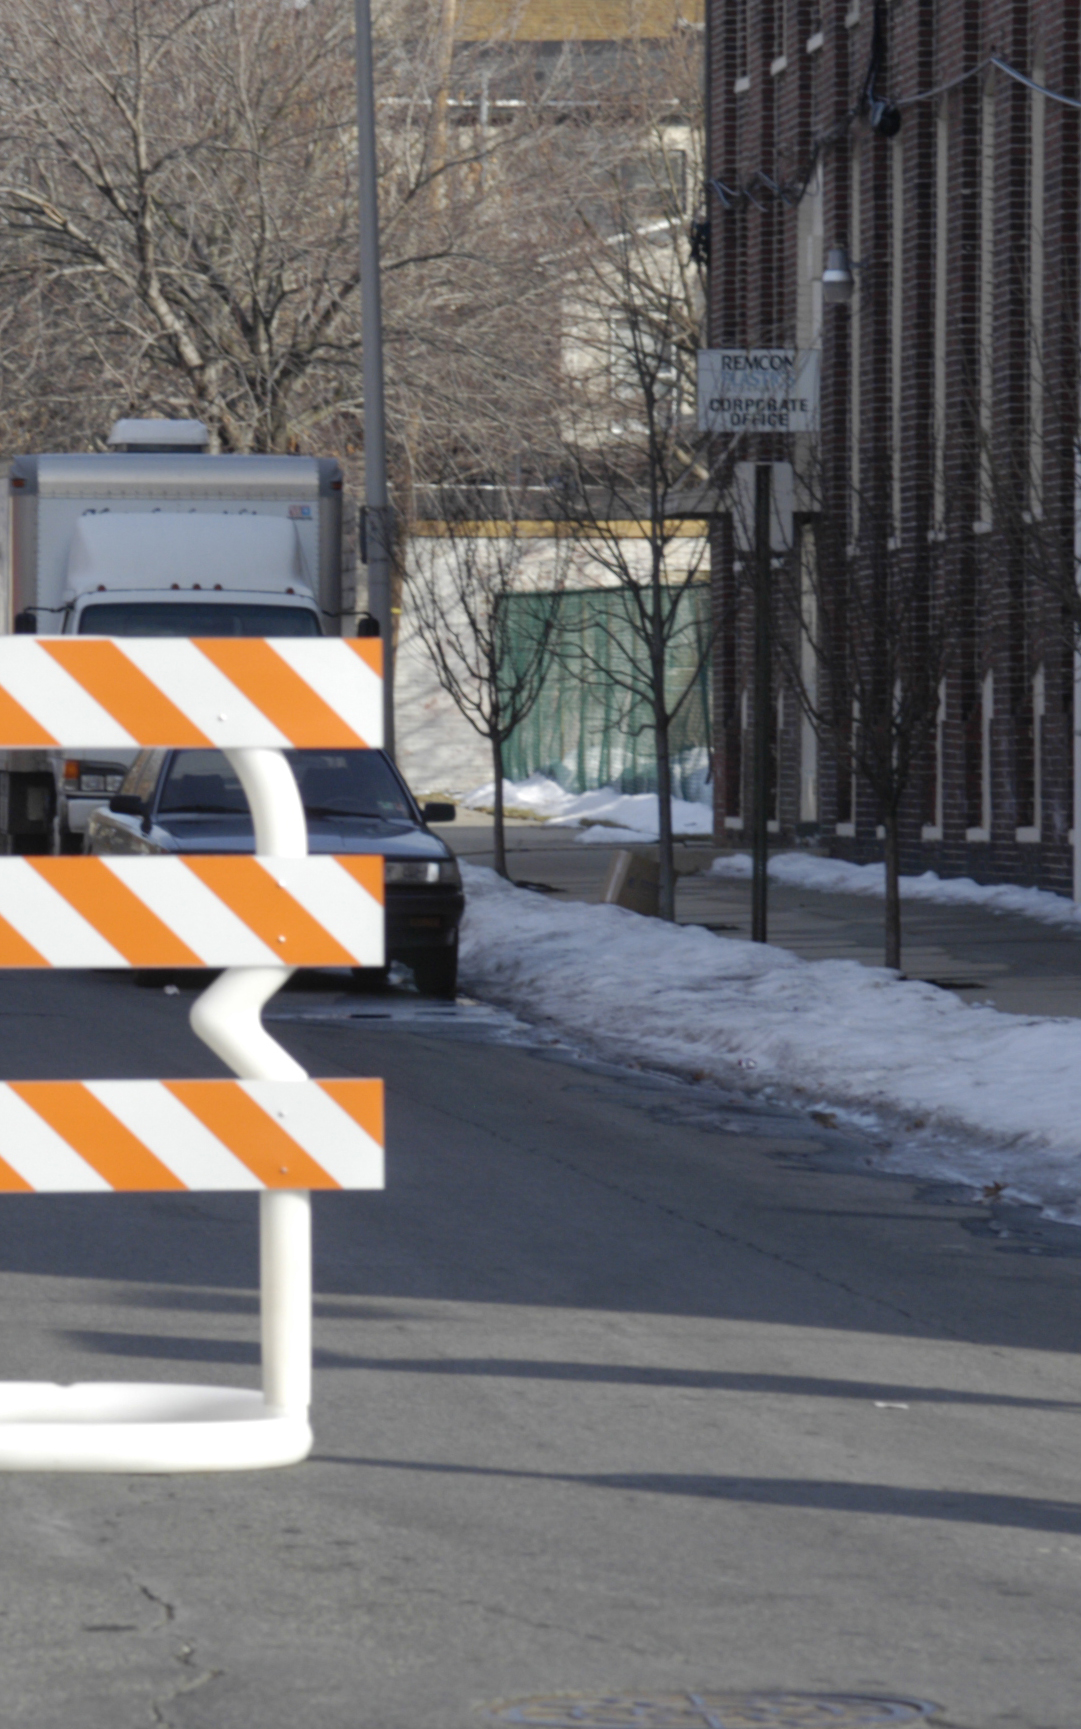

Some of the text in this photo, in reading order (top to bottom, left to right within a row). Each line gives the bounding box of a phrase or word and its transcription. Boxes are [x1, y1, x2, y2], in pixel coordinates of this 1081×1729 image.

[721, 355, 795, 371] REMCON
[709, 398, 808, 412] CORPORATE
[730, 413, 789, 427] OFFICE
